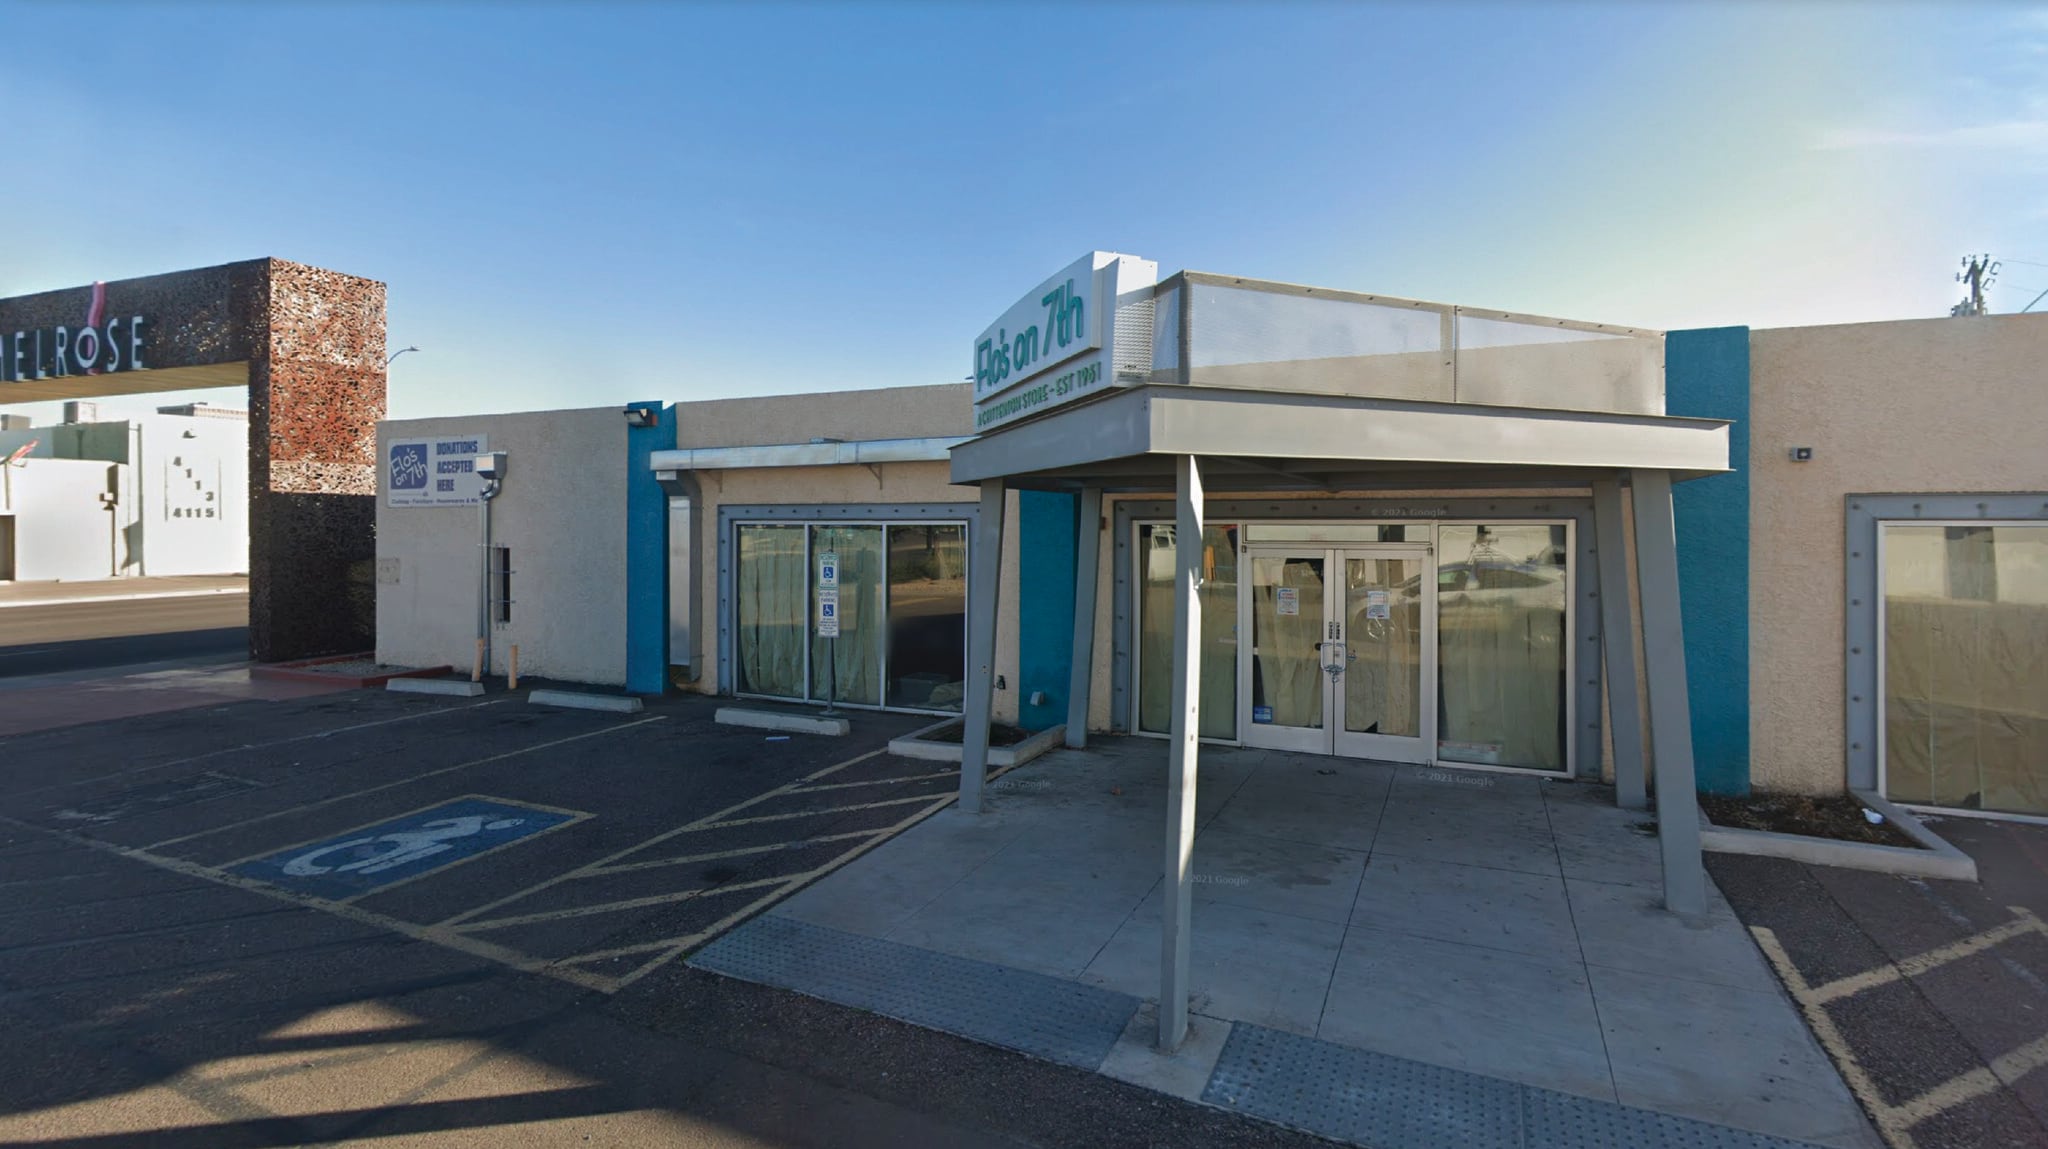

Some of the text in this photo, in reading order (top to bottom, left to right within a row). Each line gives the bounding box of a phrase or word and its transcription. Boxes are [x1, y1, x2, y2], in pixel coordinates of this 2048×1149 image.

[976, 278, 1084, 392] Flo's on 7th
[1022, 384, 1049, 409] STORE
[1056, 373, 1075, 396] EST
[436, 440, 478, 455] DONATIONS
[390, 447, 427, 486] Flo's on 7th
[436, 460, 473, 474] ACCEPTED
[436, 479, 454, 492] HERE
[173, 507, 214, 518] 4115
